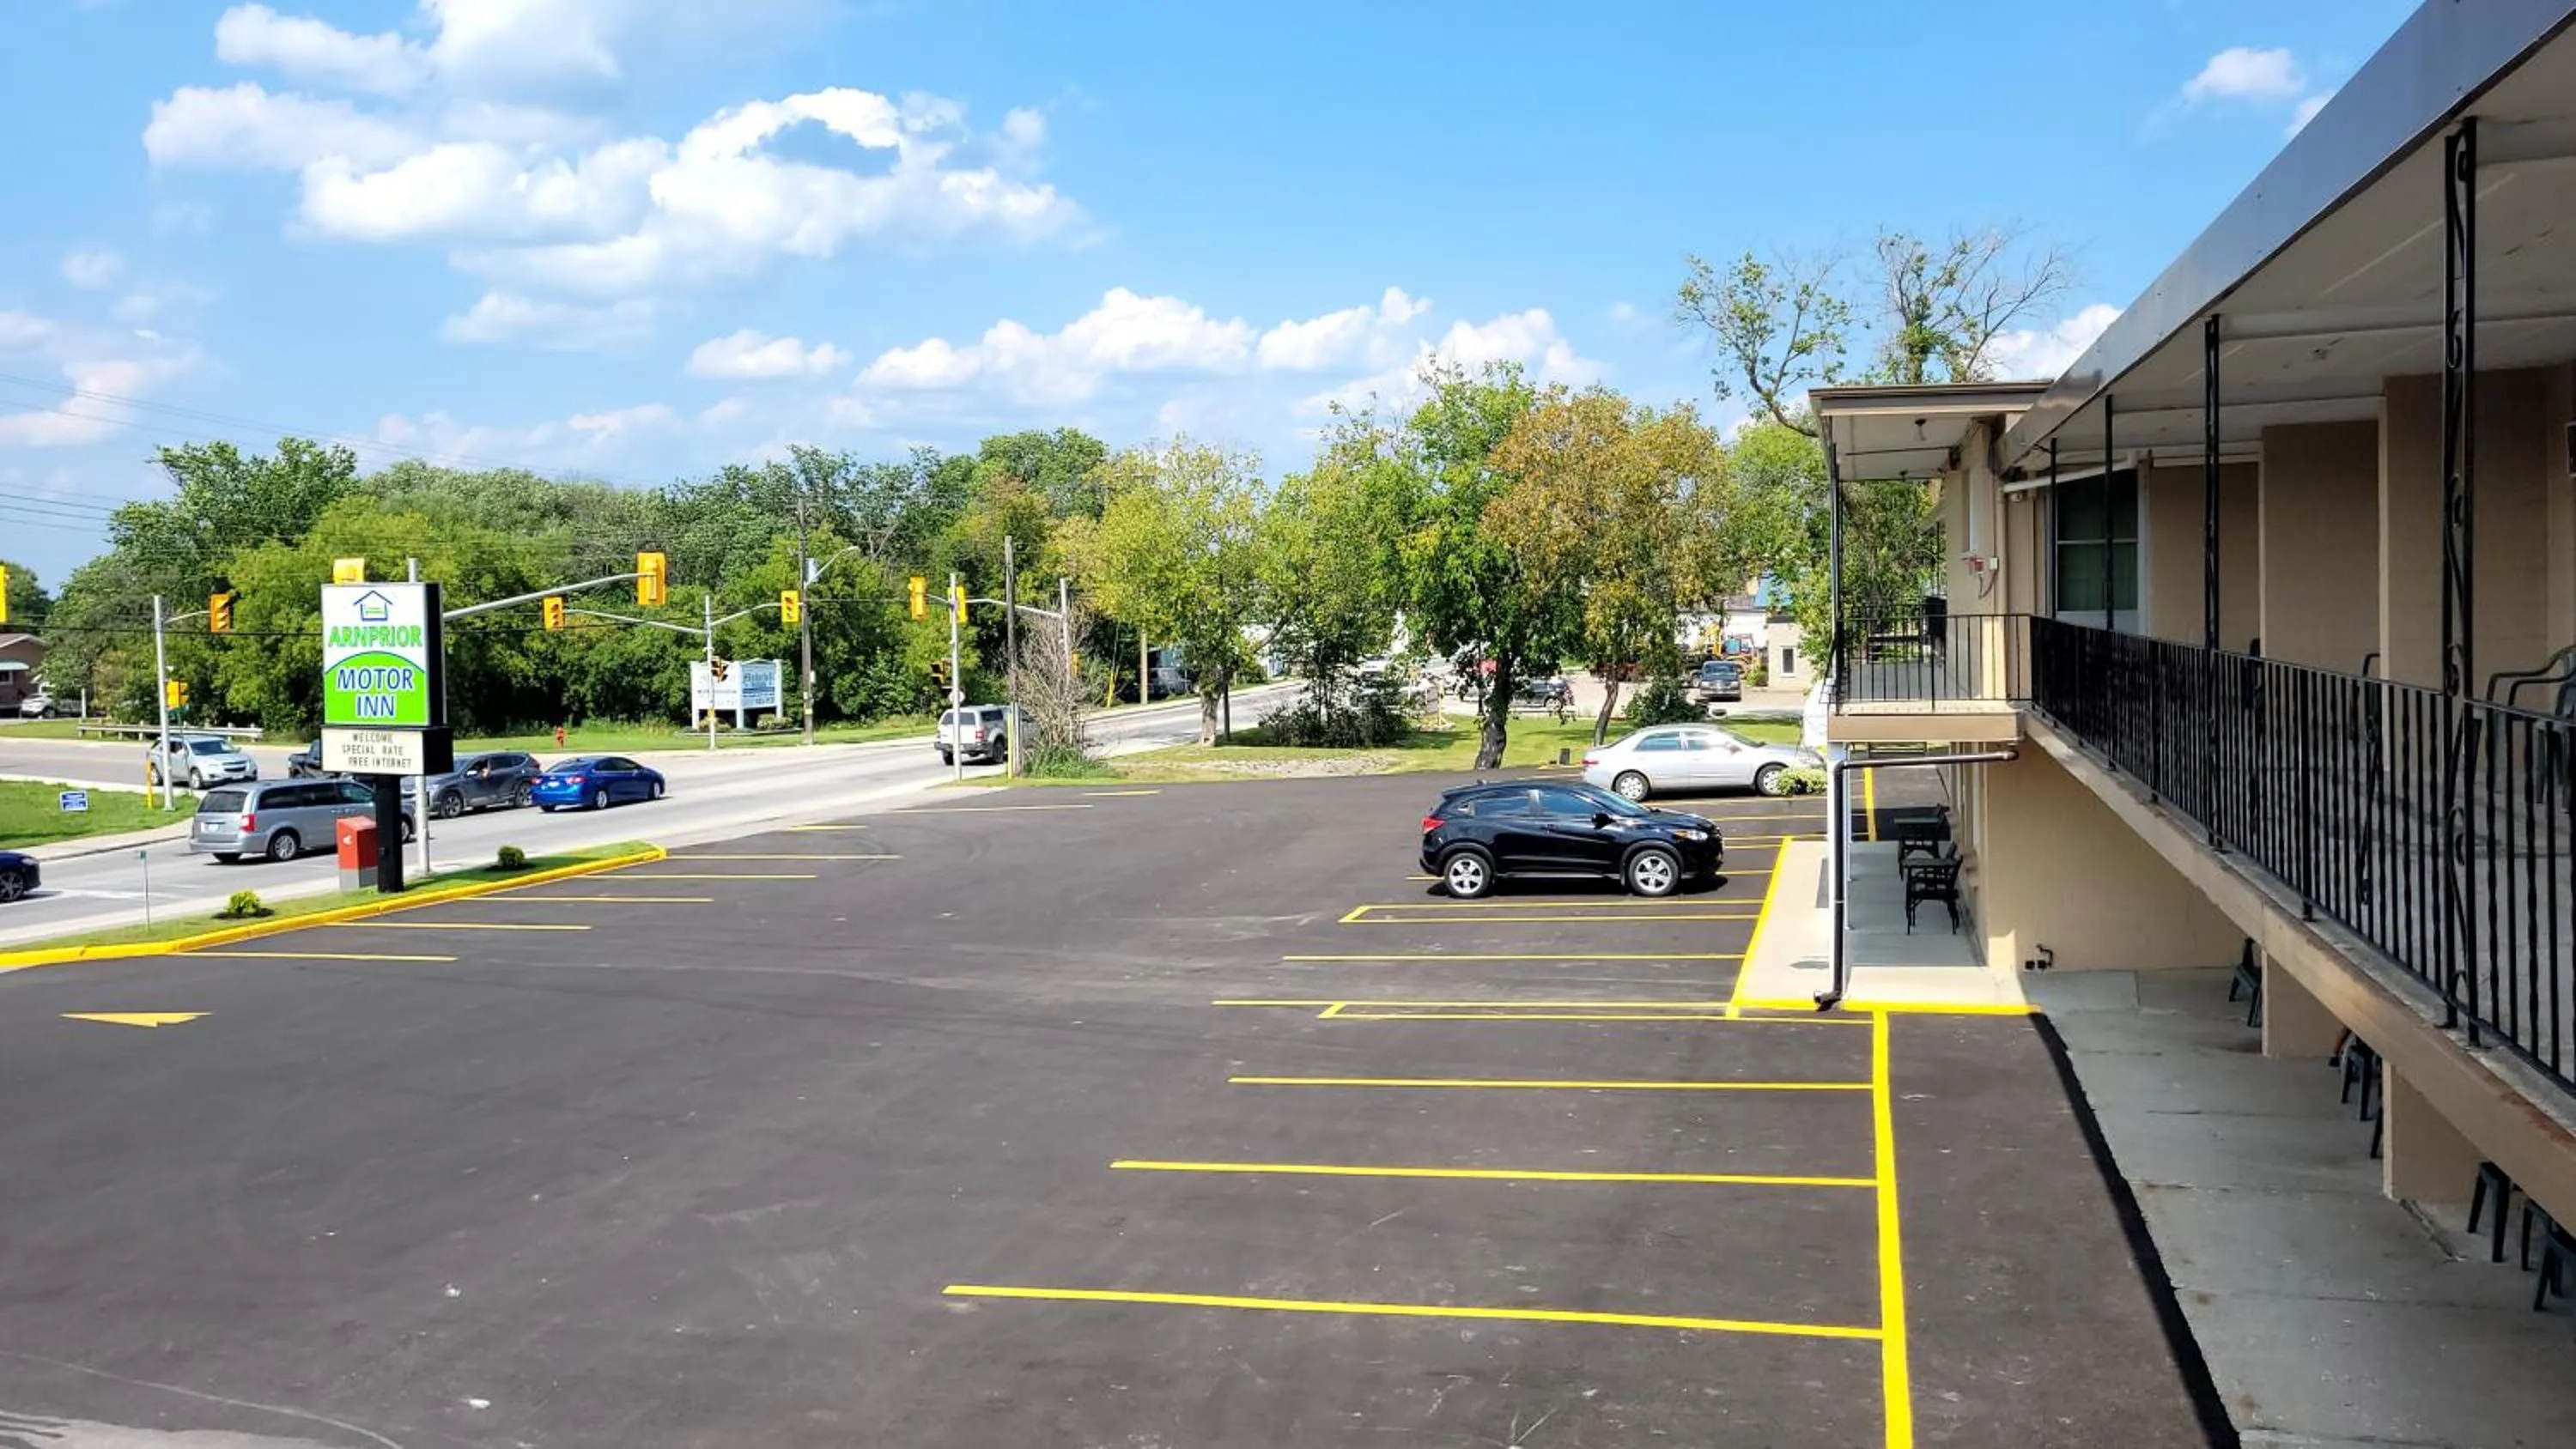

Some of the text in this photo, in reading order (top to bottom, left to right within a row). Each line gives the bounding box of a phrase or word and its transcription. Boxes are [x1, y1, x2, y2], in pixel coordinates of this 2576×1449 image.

[328, 625, 422, 648] ARNPRIOR
[337, 668, 413, 689] MOTOR
[356, 696, 395, 717] INN
[352, 732, 393, 743] WELCOME
[342, 744, 404, 755] SPECIAL RATE
[349, 756, 412, 768] FREE INTERNET
